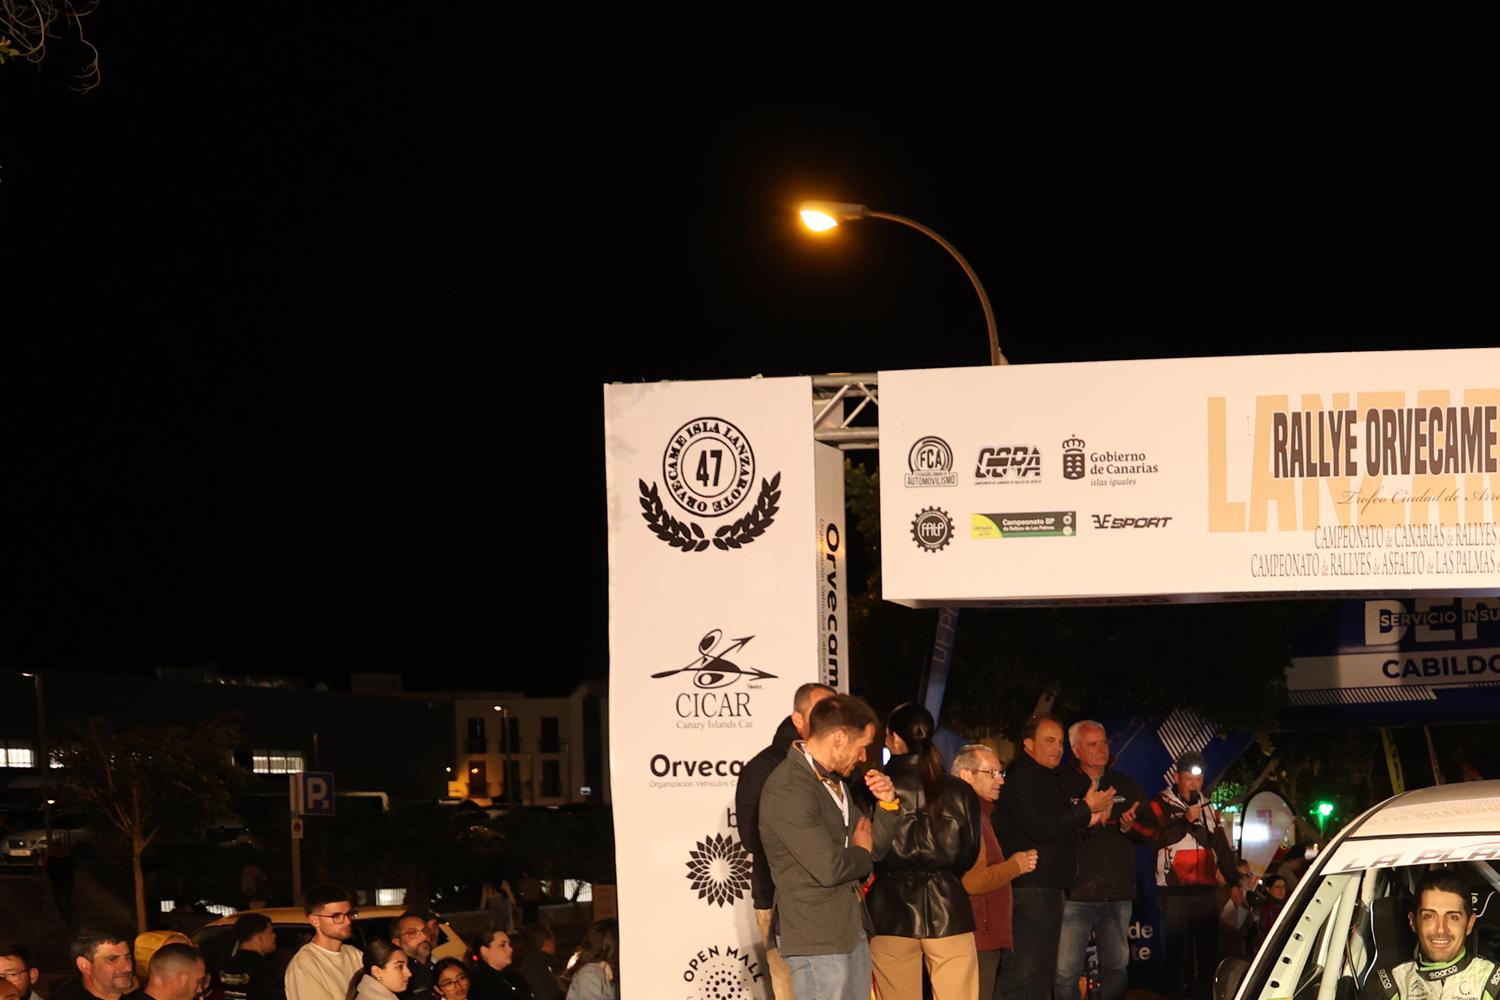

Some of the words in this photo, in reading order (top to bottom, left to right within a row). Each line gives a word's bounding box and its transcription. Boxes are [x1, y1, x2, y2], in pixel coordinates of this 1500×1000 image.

[689, 421, 720, 438] ISLA
[1273, 410, 1358, 478] RALLYE
[1365, 405, 1498, 476] ORVECAME
[696, 450, 723, 487] 47
[920, 449, 942, 469] FCA
[1090, 451, 1146, 463] Gobierno
[1090, 464, 1104, 475] de
[1106, 463, 1158, 474] Canarias
[1109, 478, 1136, 488] iguales
[1338, 487, 1386, 515] Trofeo
[1390, 485, 1442, 505] Ciudad
[1445, 488, 1461, 503] de
[1314, 524, 1384, 549] CAMPEONATO
[1394, 523, 1445, 548] CANARIAS
[1455, 522, 1497, 546] RALLYES
[1250, 553, 1320, 578] CAMPEONATO
[1330, 551, 1371, 576] RALLYES
[1382, 550, 1425, 575] ASFALTO
[1435, 549, 1454, 574] LAS
[1455, 548, 1496, 574] PALMAS
[826, 522, 840, 687] Orvecam
[1380, 610, 1457, 628] SERVICIO
[676, 692, 753, 718] CICAR
[676, 720, 705, 730] Canary
[707, 719, 739, 729] Islands
[738, 719, 753, 729] Car
[650, 753, 745, 778] Orveca
[307, 777, 327, 809] P
[1340, 852, 1396, 872] LA
[683, 945, 720, 983] OPEN
[727, 945, 764, 983] MALL
[1429, 965, 1458, 980] sparco
